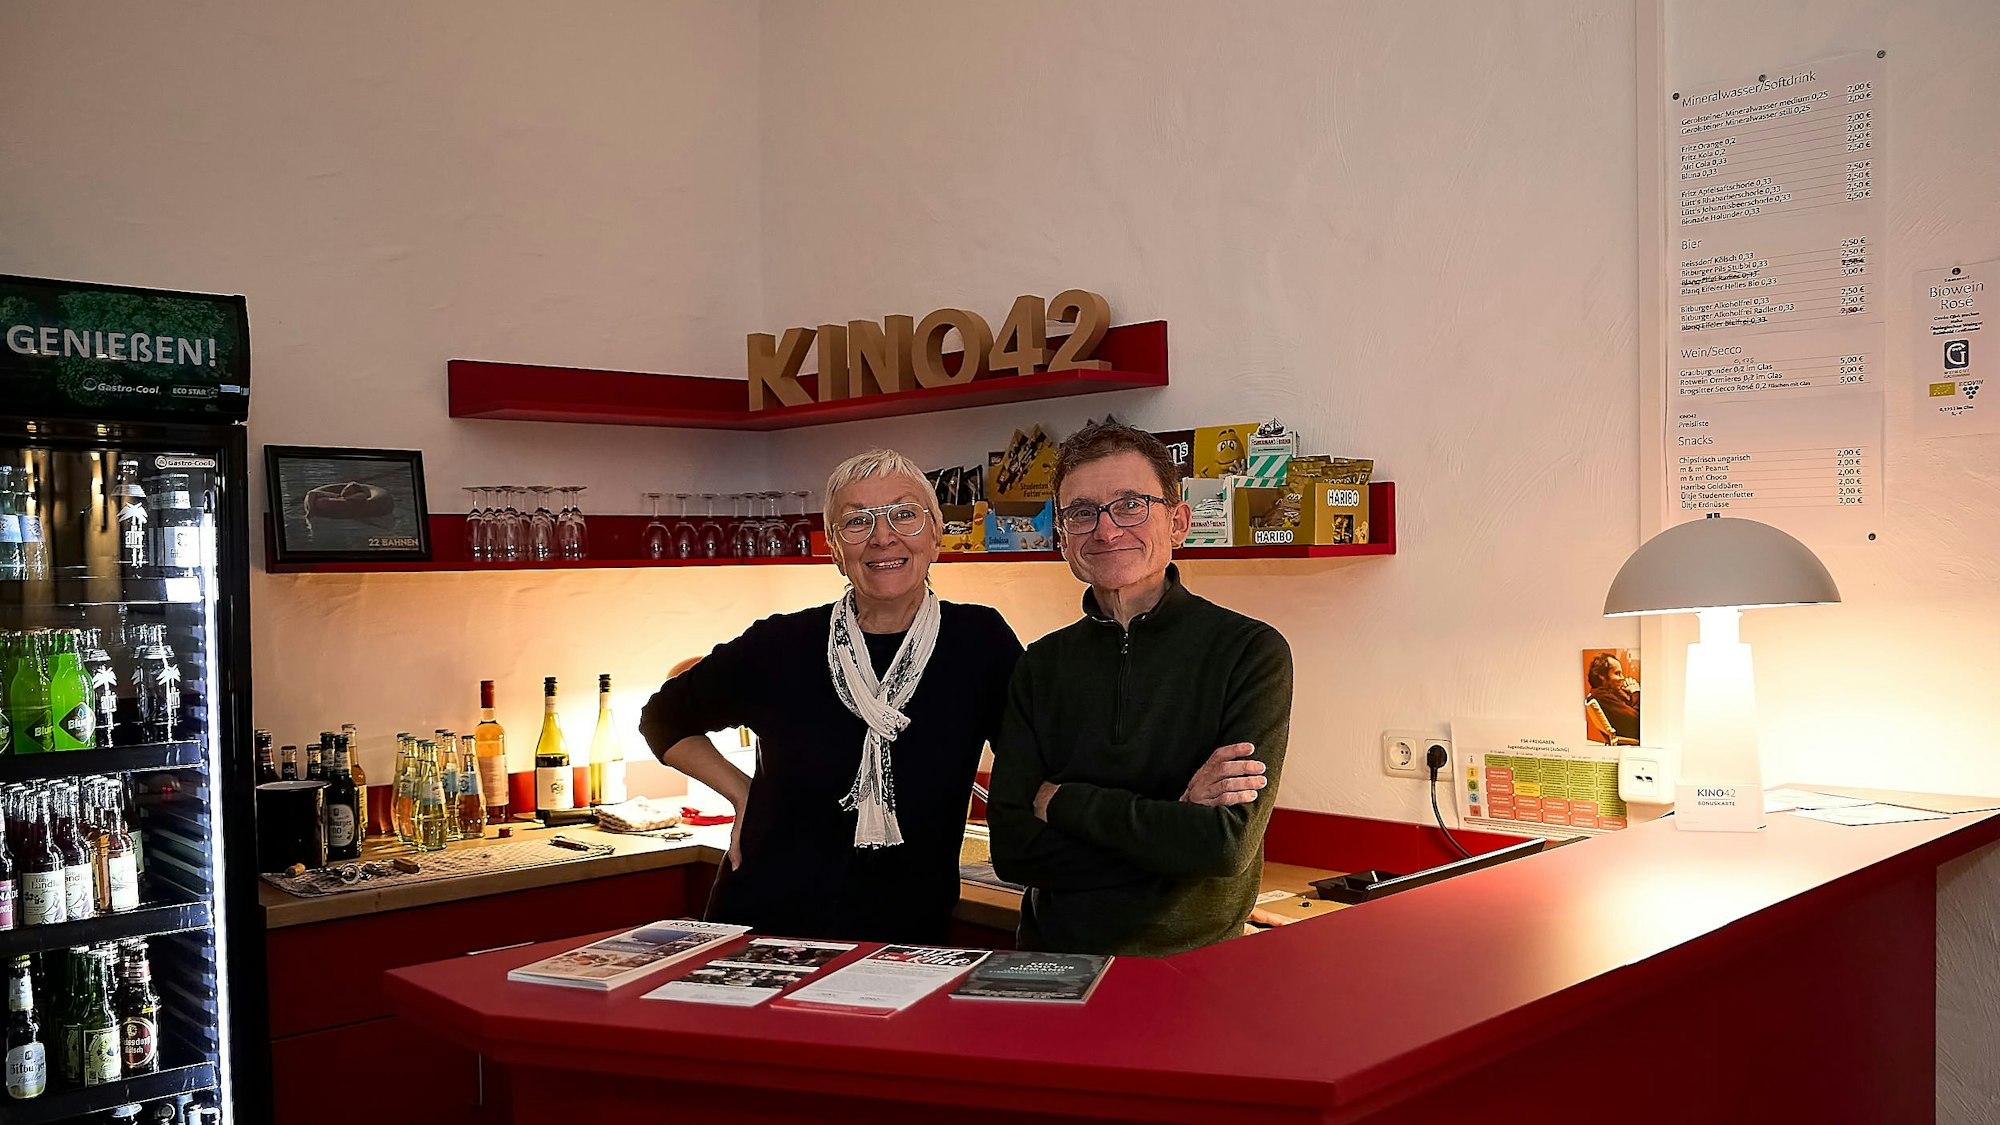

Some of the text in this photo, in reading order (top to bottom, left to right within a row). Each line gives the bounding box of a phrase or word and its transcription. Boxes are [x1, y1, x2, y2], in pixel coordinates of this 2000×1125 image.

[1682, 70, 1816, 107] Mineralwasser/Softdrink
[1681, 83, 1864, 125] Gerolsteiner Mineralwasser medium 0,25 2,00
[1681, 93, 1864, 134] Gerolsteiner Mineralwasser still 0,25 2,00
[1698, 141, 1724, 149] Orange
[1725, 137, 1736, 145] 0,2
[1848, 113, 1864, 123] 2,00
[1681, 154, 1696, 162] Fritz
[1698, 151, 1713, 159] Kola
[1848, 123, 1864, 132] 2,00
[1695, 160, 1711, 169] Cola
[1712, 158, 1727, 166] 0,33
[1848, 132, 1864, 142] 2,50
[1702, 168, 1717, 177] 0,33
[1848, 142, 1864, 152] 2,50
[1681, 162, 1864, 198] Fritz Apfelsaftschorle 0,33 2,50
[1702, 189, 1764, 204] Rhabarberschorle
[1765, 186, 1781, 195] 0,33
[1847, 172, 1864, 181] 2,50
[1701, 197, 1774, 214] Johannisbeerschorle
[1774, 193, 1791, 202] 0,33
[1847, 181, 1864, 191] 2,50
[1681, 191, 1864, 225] Bionade Holunder 0,33 2,50
[1681, 239, 1702, 250] Bier
[1681, 238, 1859, 268] Reissdorf Kölsch 0,33 2,50
[1681, 268, 1713, 277] Bitburger
[1727, 262, 1751, 271] Stubbi
[1752, 260, 1768, 269] 0,33
[1841, 248, 1859, 257] 2,50
[1701, 284, 1724, 292] Eifeler
[1724, 281, 1747, 290] Helles
[1748, 278, 1760, 287] Bio
[1761, 278, 1777, 286] 0,33
[1930, 281, 1984, 297] Biowein
[1680, 287, 1858, 313] Bitburger Alkoholfrei 0,33 2,50
[1680, 296, 1858, 322] Bitburger Alkoholfrei Radler 0,33 2,50
[1941, 295, 1974, 310] Rosé
[747, 288, 1112, 412] KINO42
[1680, 346, 1742, 358] Wein/Secco
[1680, 366, 1733, 377] Grauburgunder
[1746, 364, 1756, 372] im
[1757, 363, 1773, 371] Glas
[1840, 356, 1857, 365] 5,00
[1680, 378, 1708, 386] Rotwein
[1840, 366, 1857, 375] 5,00
[172, 387, 187, 395] ECO
[188, 388, 207, 396] STAR
[1680, 386, 1714, 396] Brogsitter
[1714, 385, 1735, 393] Secco
[1736, 383, 1754, 391] Rosé
[1755, 382, 1767, 391] 0,2
[1840, 375, 1857, 384] 5,00
[1678, 420, 1709, 428] Preisliste
[1678, 435, 1714, 446] Snacks
[1679, 450, 1854, 465] Chipsfrisch ungarisch 2,00
[1837, 459, 1854, 467] 2,00
[1837, 469, 1855, 477] 2,00
[1698, 490, 1754, 499] Studentenfutter
[1838, 488, 1856, 496] 2,00
[1707, 482, 1743, 490] Goldbären
[1838, 478, 1855, 487] 2,00
[1328, 489, 1360, 507] HARIBO
[1839, 497, 1856, 506] 2,00
[368, 538, 419, 547] 22 BAHNEN
[1255, 530, 1294, 544] HARIBO
[1697, 788, 1736, 798] KINO42
